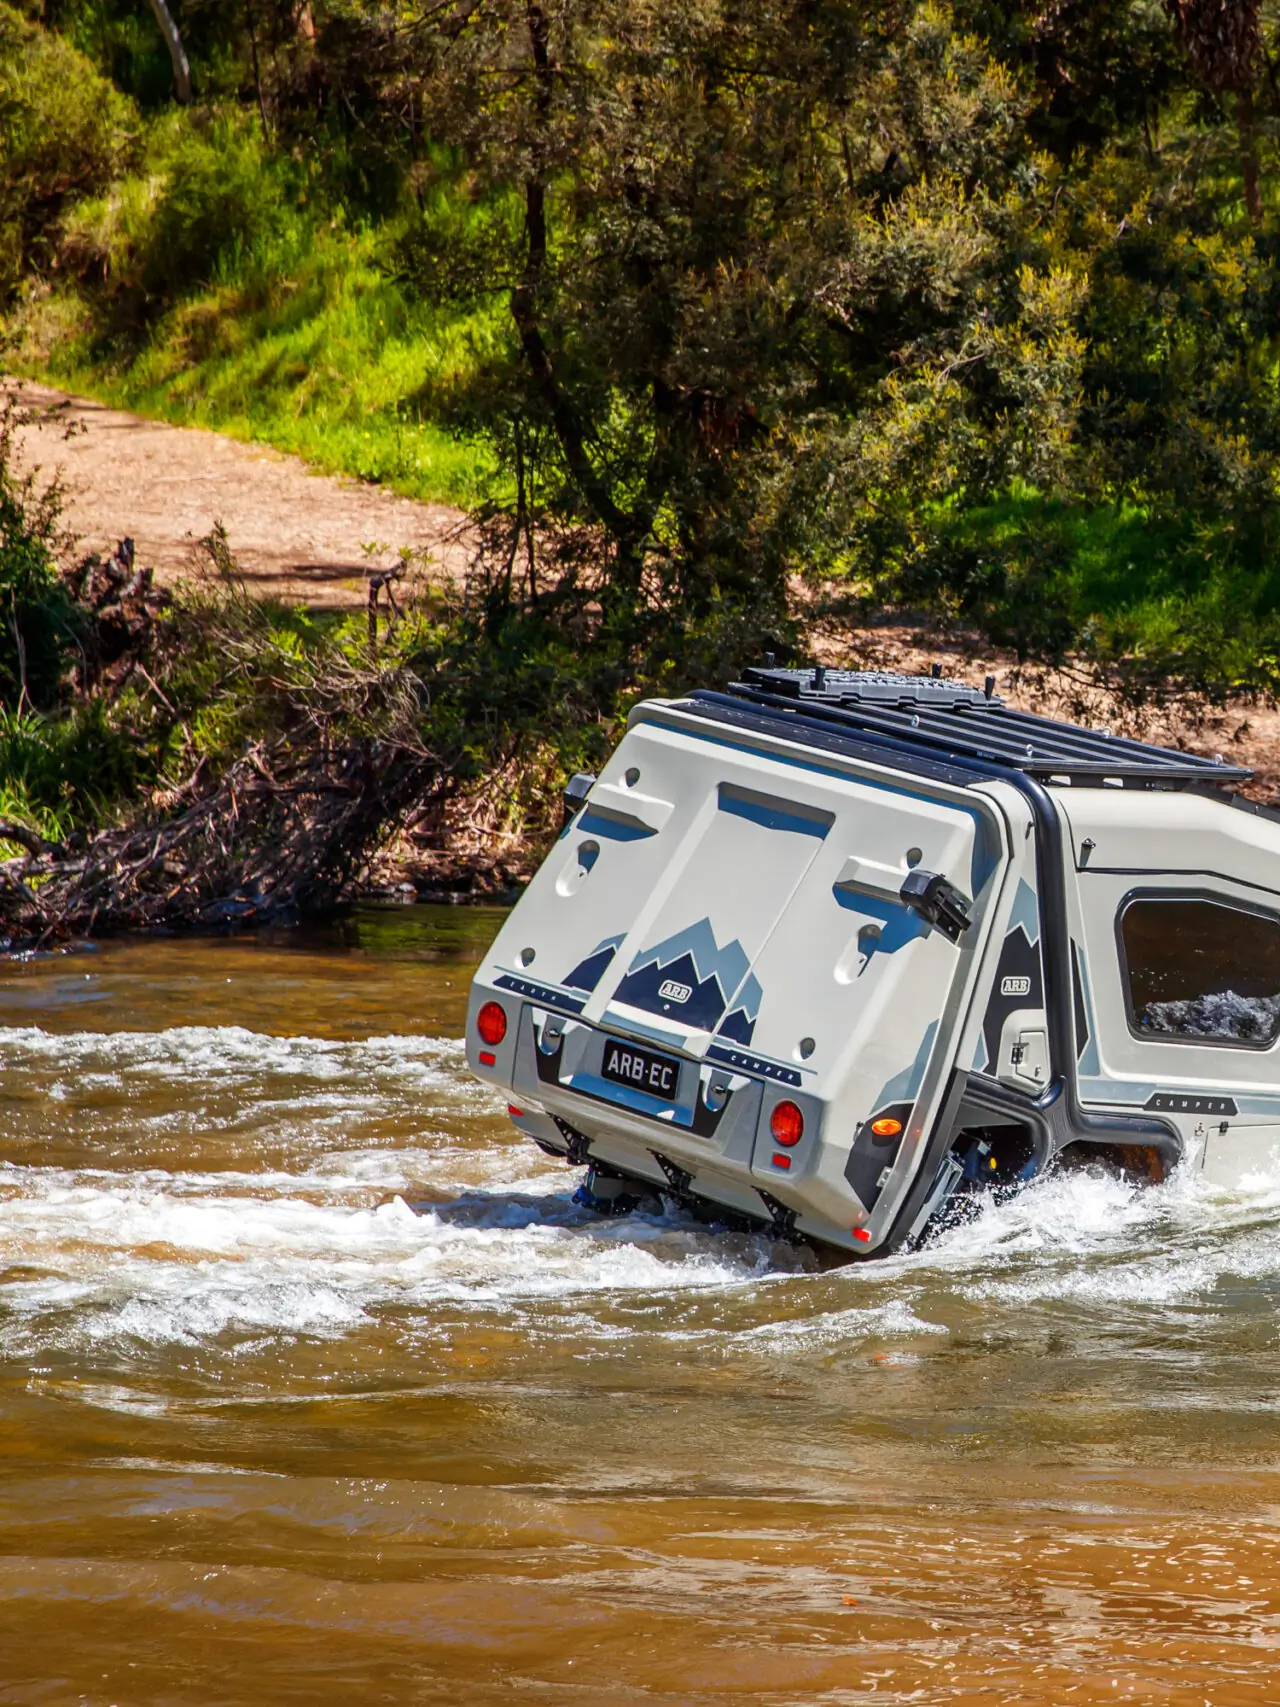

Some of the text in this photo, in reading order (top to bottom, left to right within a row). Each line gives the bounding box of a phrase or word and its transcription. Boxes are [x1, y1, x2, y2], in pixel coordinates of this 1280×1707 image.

[661, 983, 689, 1000] ARB
[1003, 979, 1028, 992] ARB
[730, 1055, 795, 1081] CAMPER
[1155, 1099, 1225, 1110] CAMPER
